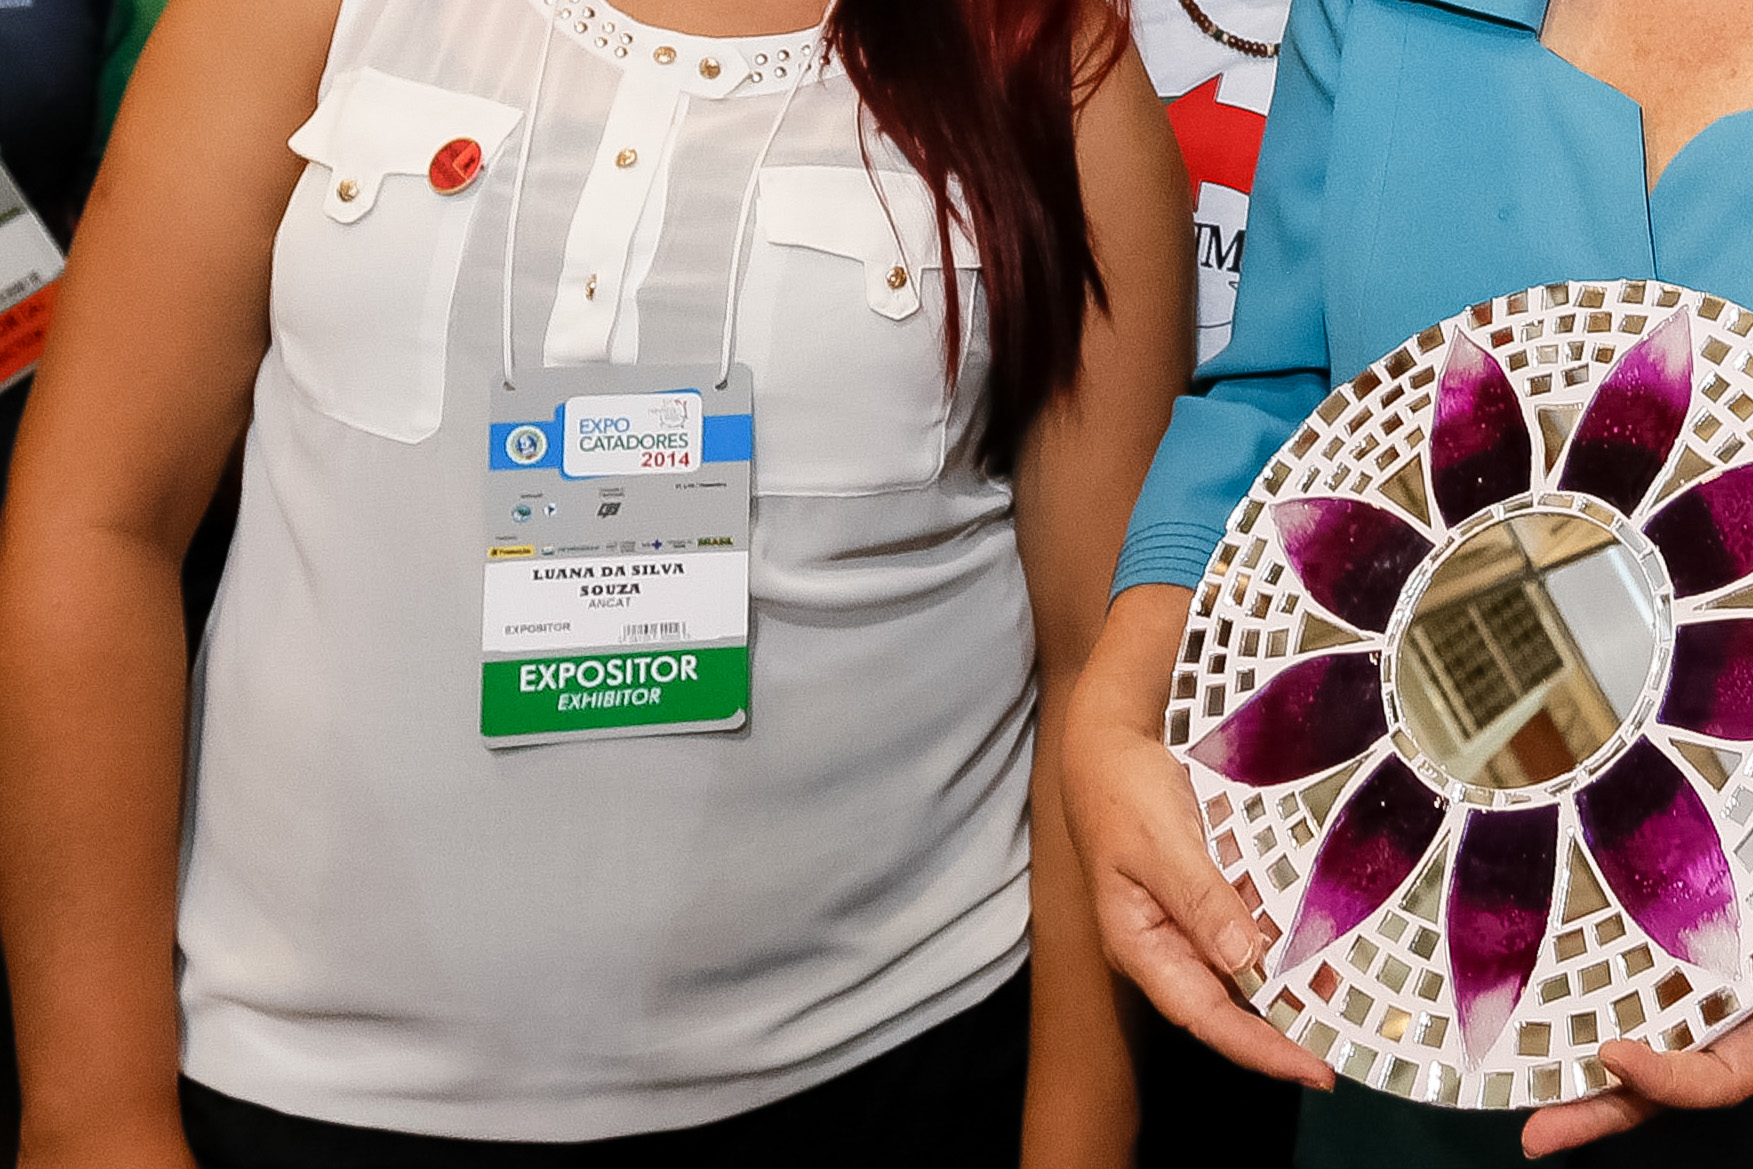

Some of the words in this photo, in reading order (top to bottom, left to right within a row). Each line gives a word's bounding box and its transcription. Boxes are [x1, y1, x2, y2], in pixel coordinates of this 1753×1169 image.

[579, 418, 630, 433] EXPO
[579, 433, 689, 452] CATADORES
[641, 452, 690, 467] 2014
[532, 566, 595, 581] LUANA
[601, 564, 626, 578] DA
[632, 563, 685, 576] SILVA
[580, 583, 641, 597] SOUZA
[504, 622, 571, 635] EXPOSITOR
[519, 655, 698, 693] EXPOSITOR
[557, 687, 662, 711] EXHIBITOR
